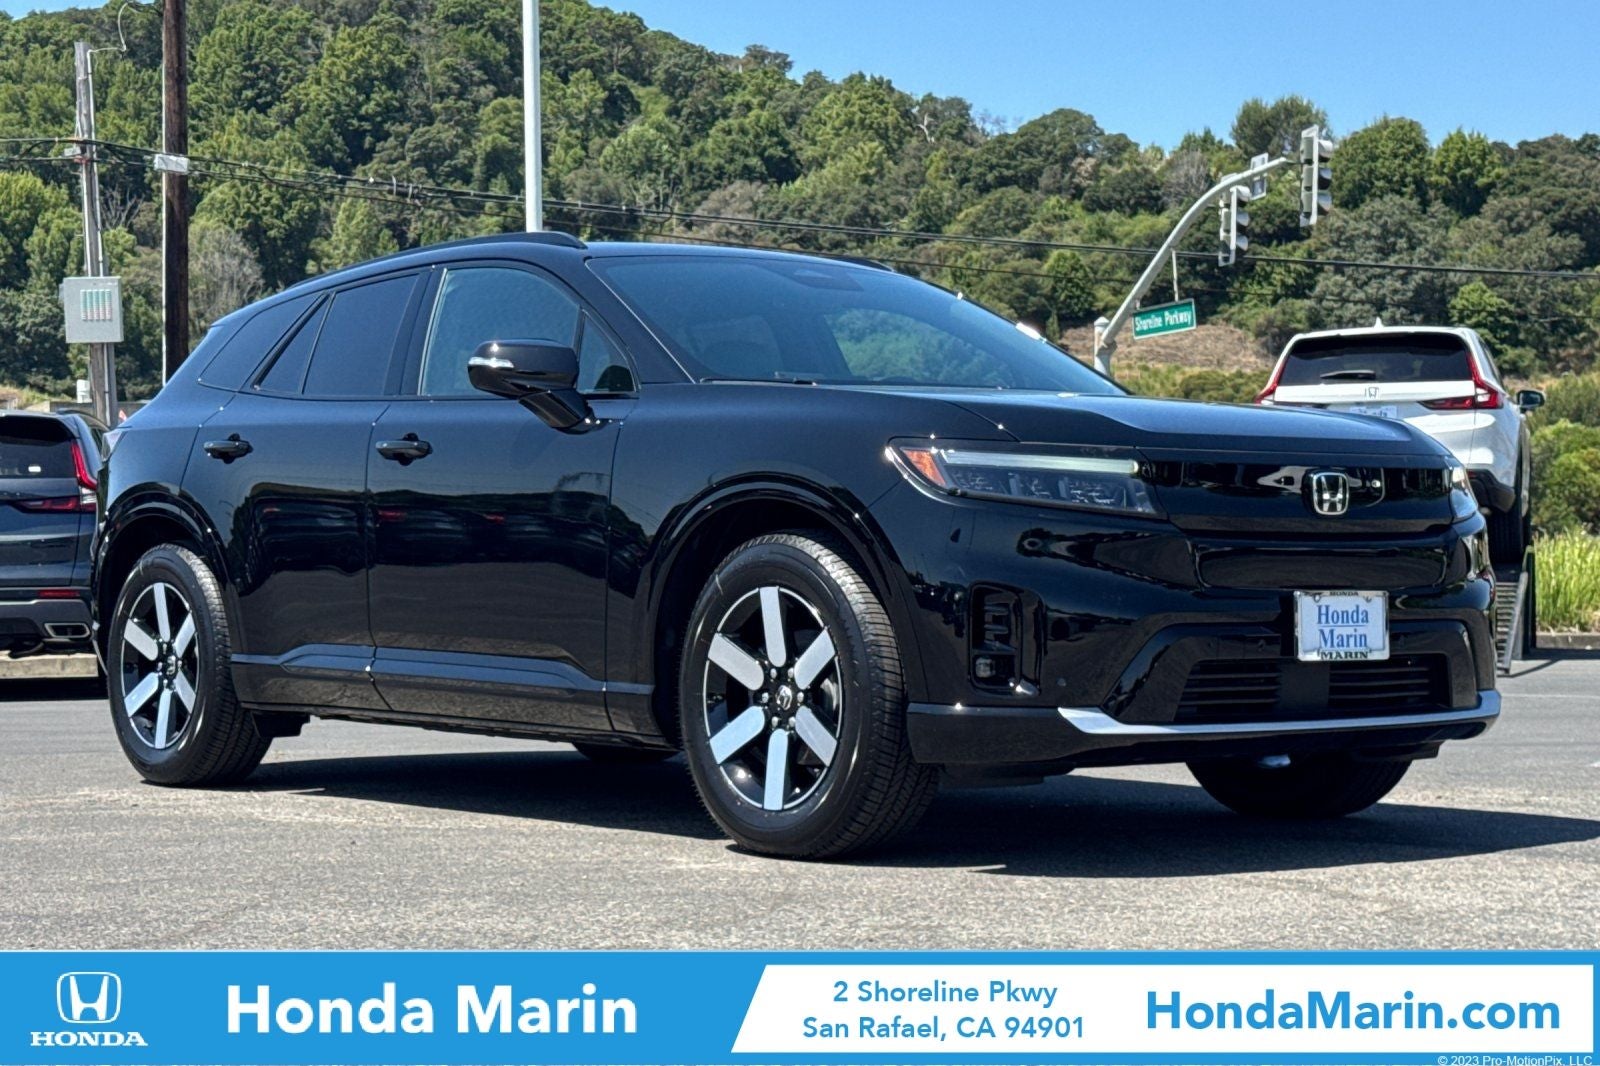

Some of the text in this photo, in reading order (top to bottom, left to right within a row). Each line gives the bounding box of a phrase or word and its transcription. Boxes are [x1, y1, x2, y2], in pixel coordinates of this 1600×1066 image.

[1135, 310, 1192, 331] Shoreline Parkway
[1316, 604, 1369, 624] Honda
[1318, 628, 1368, 649] Marin
[1320, 651, 1368, 660] MARIN
